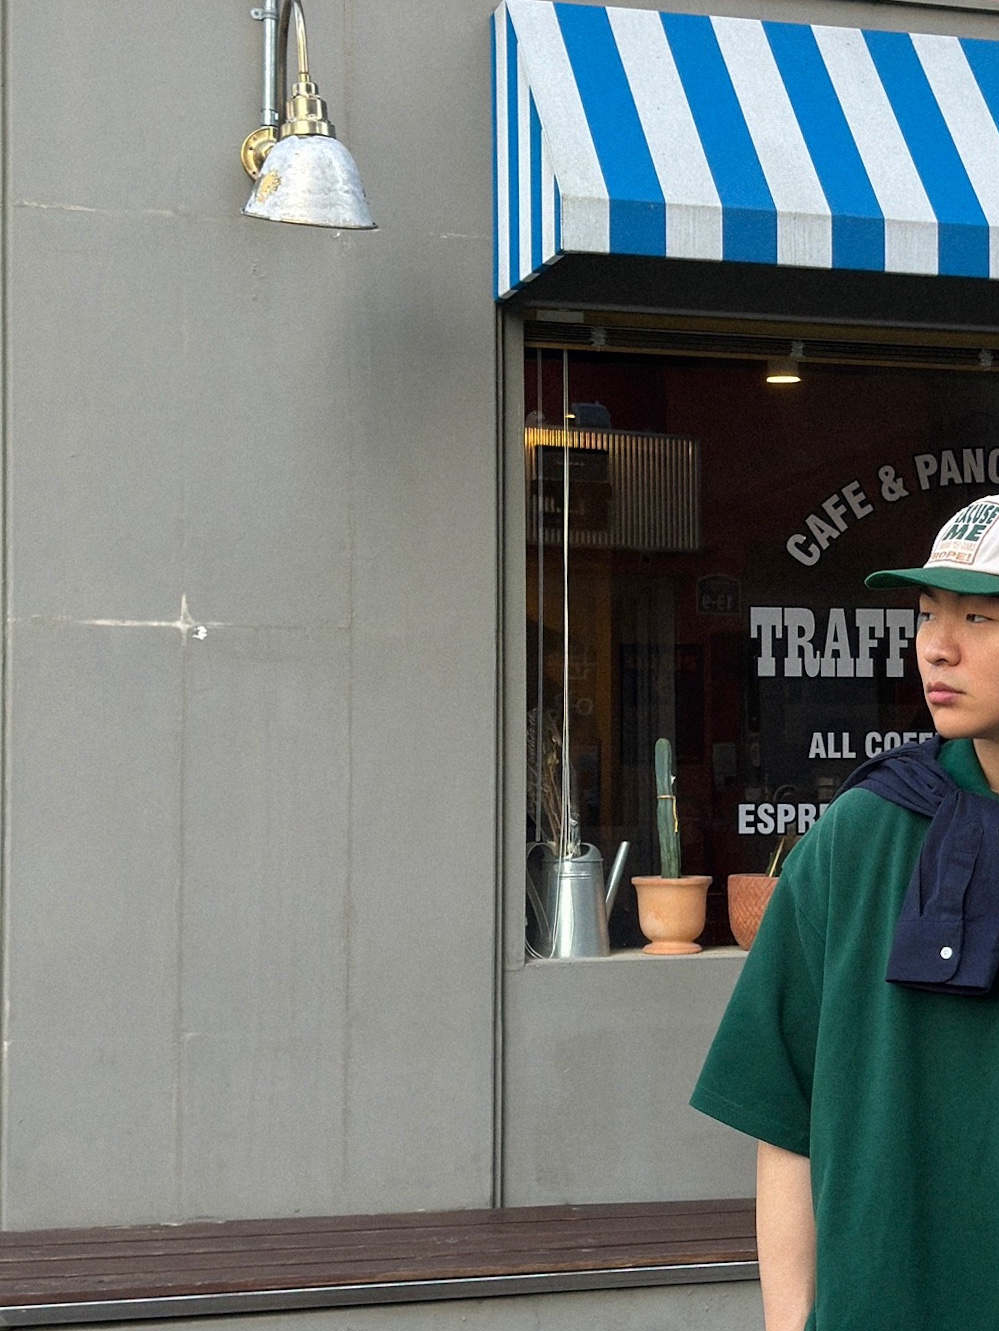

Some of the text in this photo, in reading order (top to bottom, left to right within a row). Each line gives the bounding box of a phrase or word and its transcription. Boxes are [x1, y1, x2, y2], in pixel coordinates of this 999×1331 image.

[786, 480, 874, 566] CAFE
[878, 465, 909, 502] &
[942, 524, 987, 541] ME
[750, 607, 915, 678] TRAFF
[808, 732, 857, 759] ALL
[738, 803, 829, 835] ESPR
